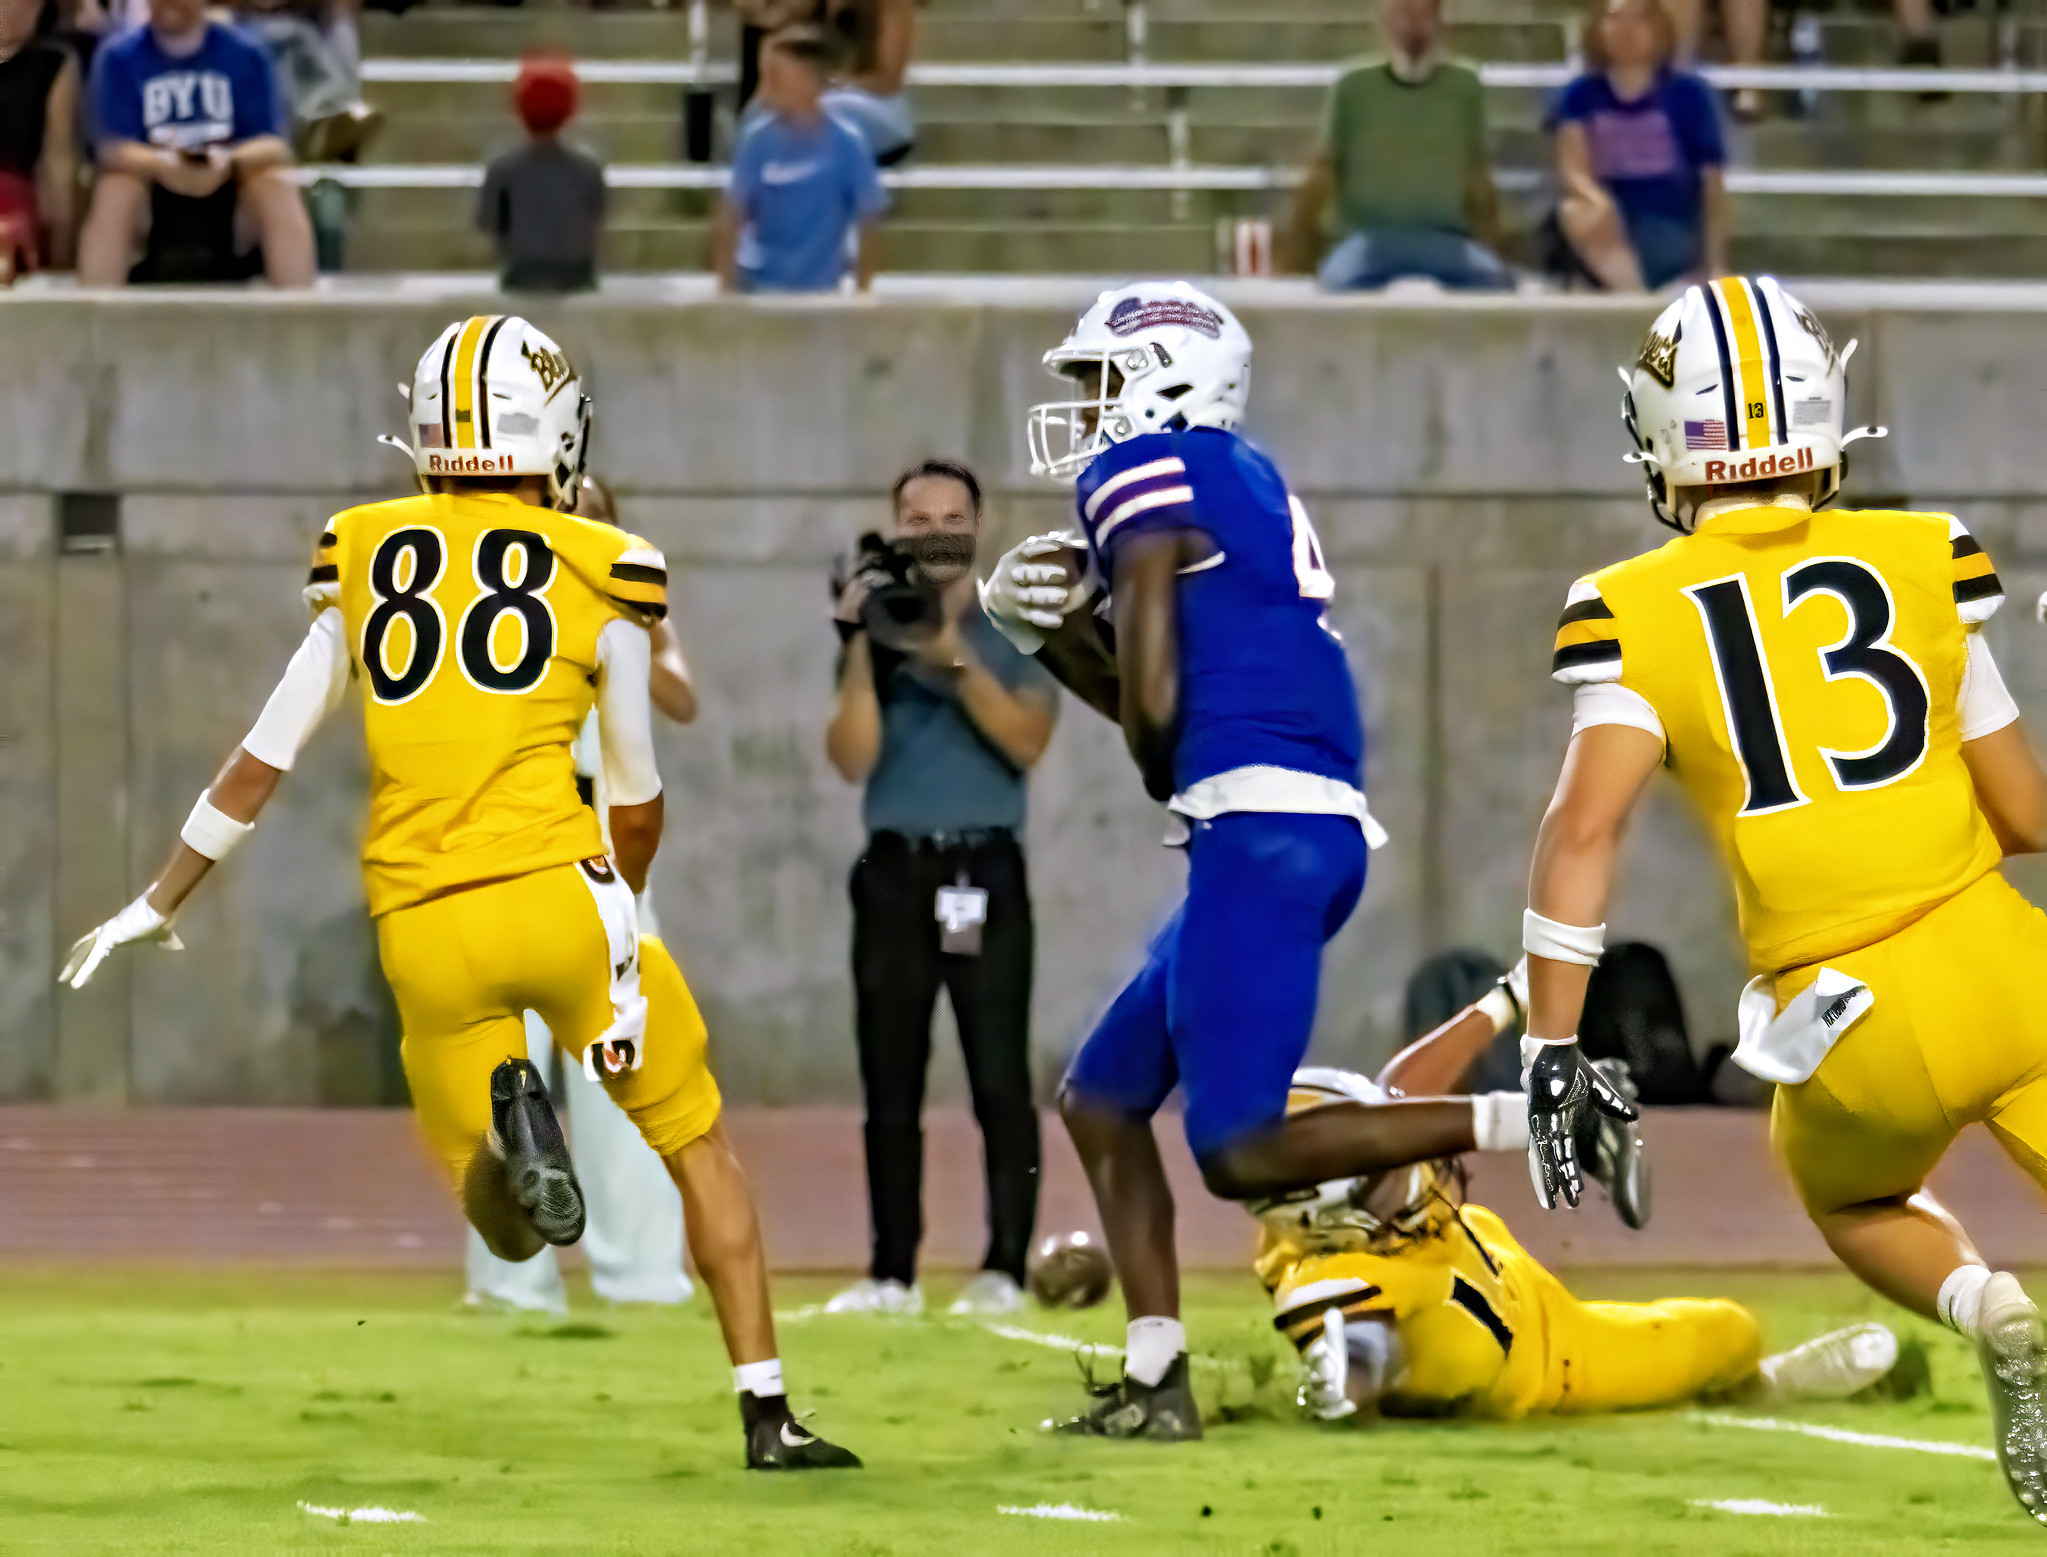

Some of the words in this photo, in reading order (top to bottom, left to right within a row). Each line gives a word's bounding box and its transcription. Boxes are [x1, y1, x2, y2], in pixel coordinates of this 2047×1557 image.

[144, 72, 234, 126] BYU
[1747, 402, 1765, 420] 13
[429, 453, 514, 473] Riddell
[1705, 447, 1813, 482] Riddell
[361, 525, 557, 706] 88
[1679, 555, 1931, 817] 13
